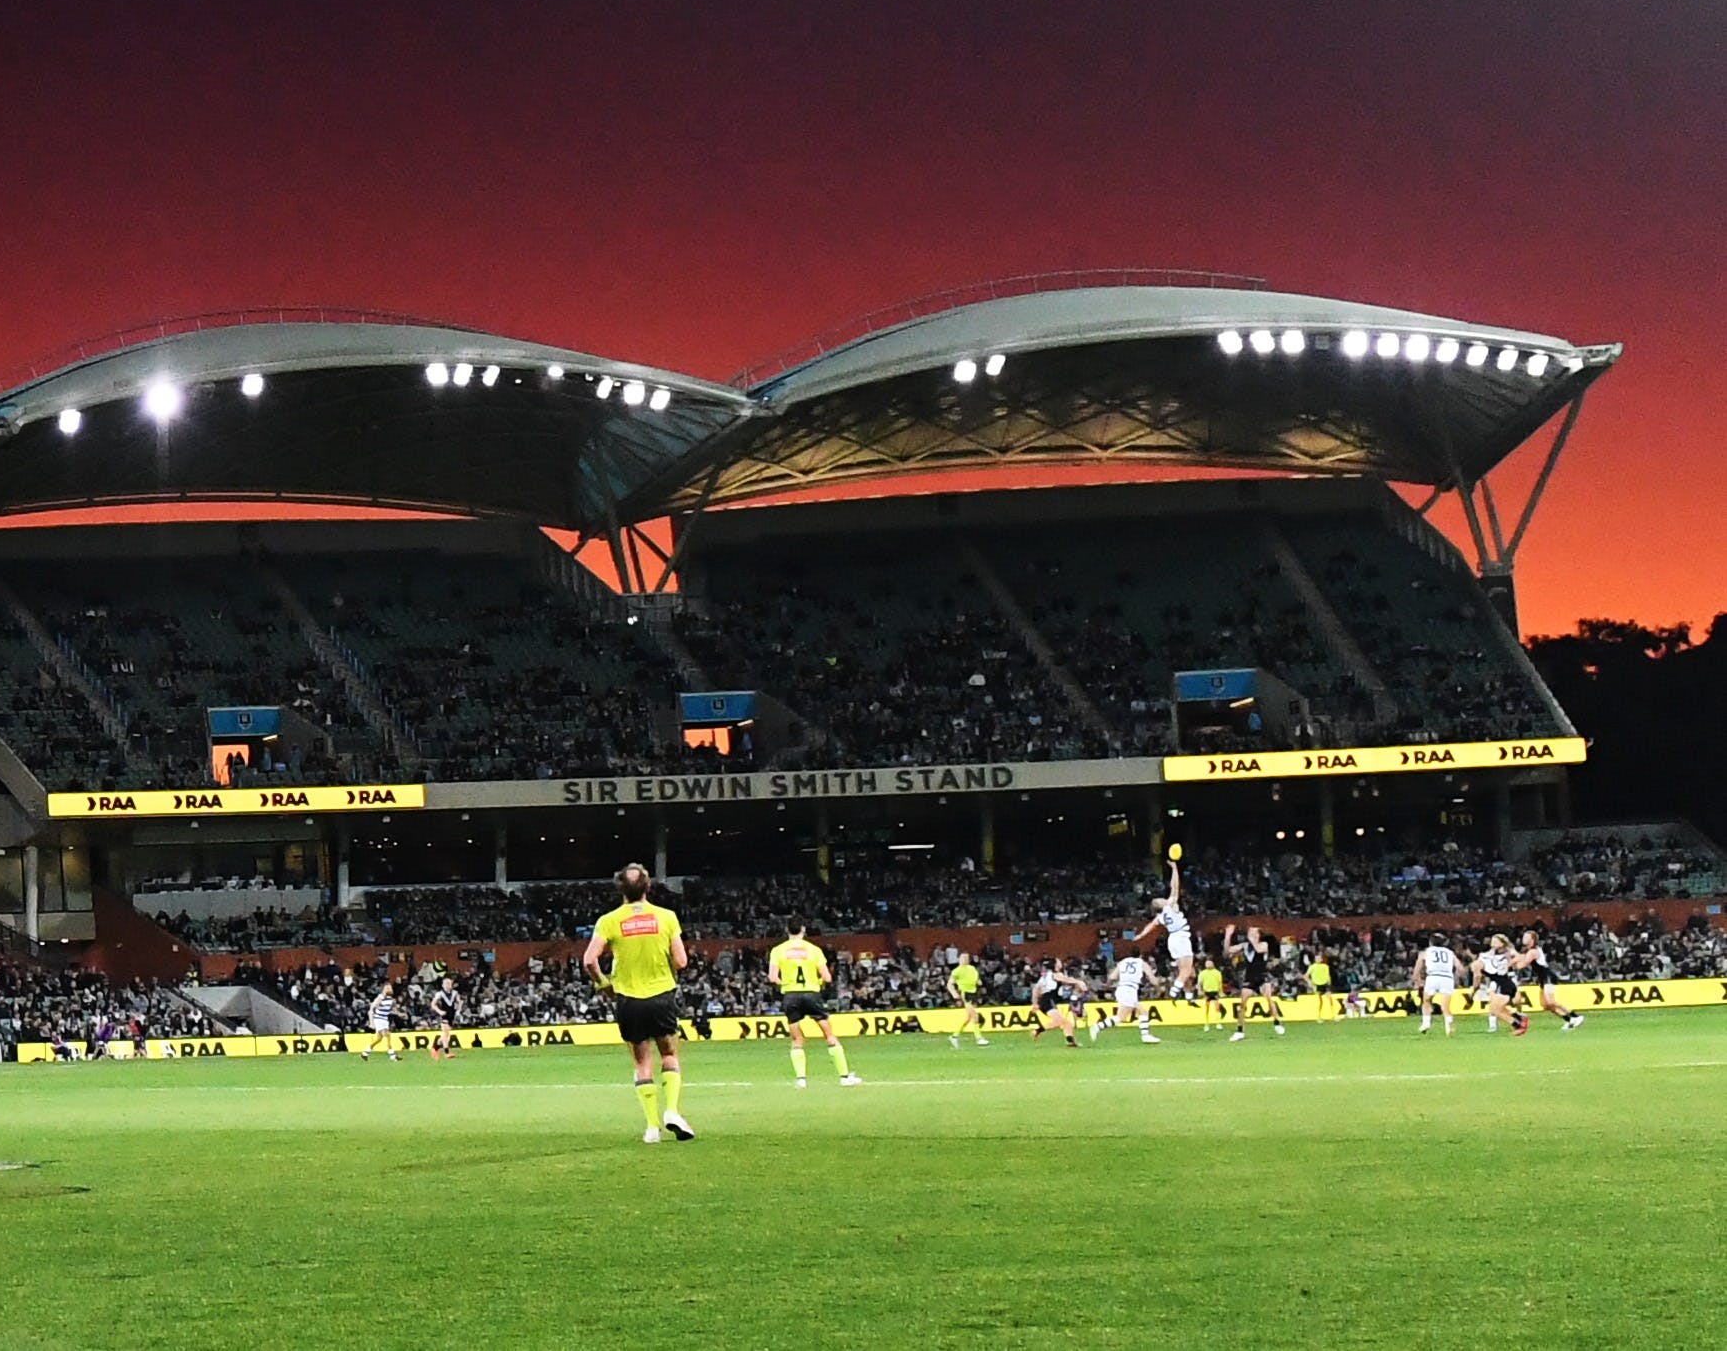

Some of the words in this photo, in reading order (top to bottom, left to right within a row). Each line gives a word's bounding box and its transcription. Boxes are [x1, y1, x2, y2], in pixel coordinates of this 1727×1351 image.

[1413, 749, 1456, 765] RAA
[1511, 744, 1555, 760] RAA
[1220, 759, 1262, 773] RAA
[1317, 754, 1358, 769] RAA
[563, 780, 619, 804] SIR
[636, 775, 753, 802] EDWIN
[770, 771, 878, 797] SMITH
[896, 764, 1015, 793] STAND
[99, 796, 137, 811] RAA
[185, 794, 224, 809] RAA
[272, 792, 310, 808] RAA
[359, 789, 398, 805] RAA
[1432, 951, 1449, 964] 30
[796, 965, 806, 988] 4
[1609, 985, 1665, 1005] RAA
[991, 1010, 1041, 1029] RAA
[527, 1029, 576, 1047] RAA
[180, 1041, 227, 1058] RAA
